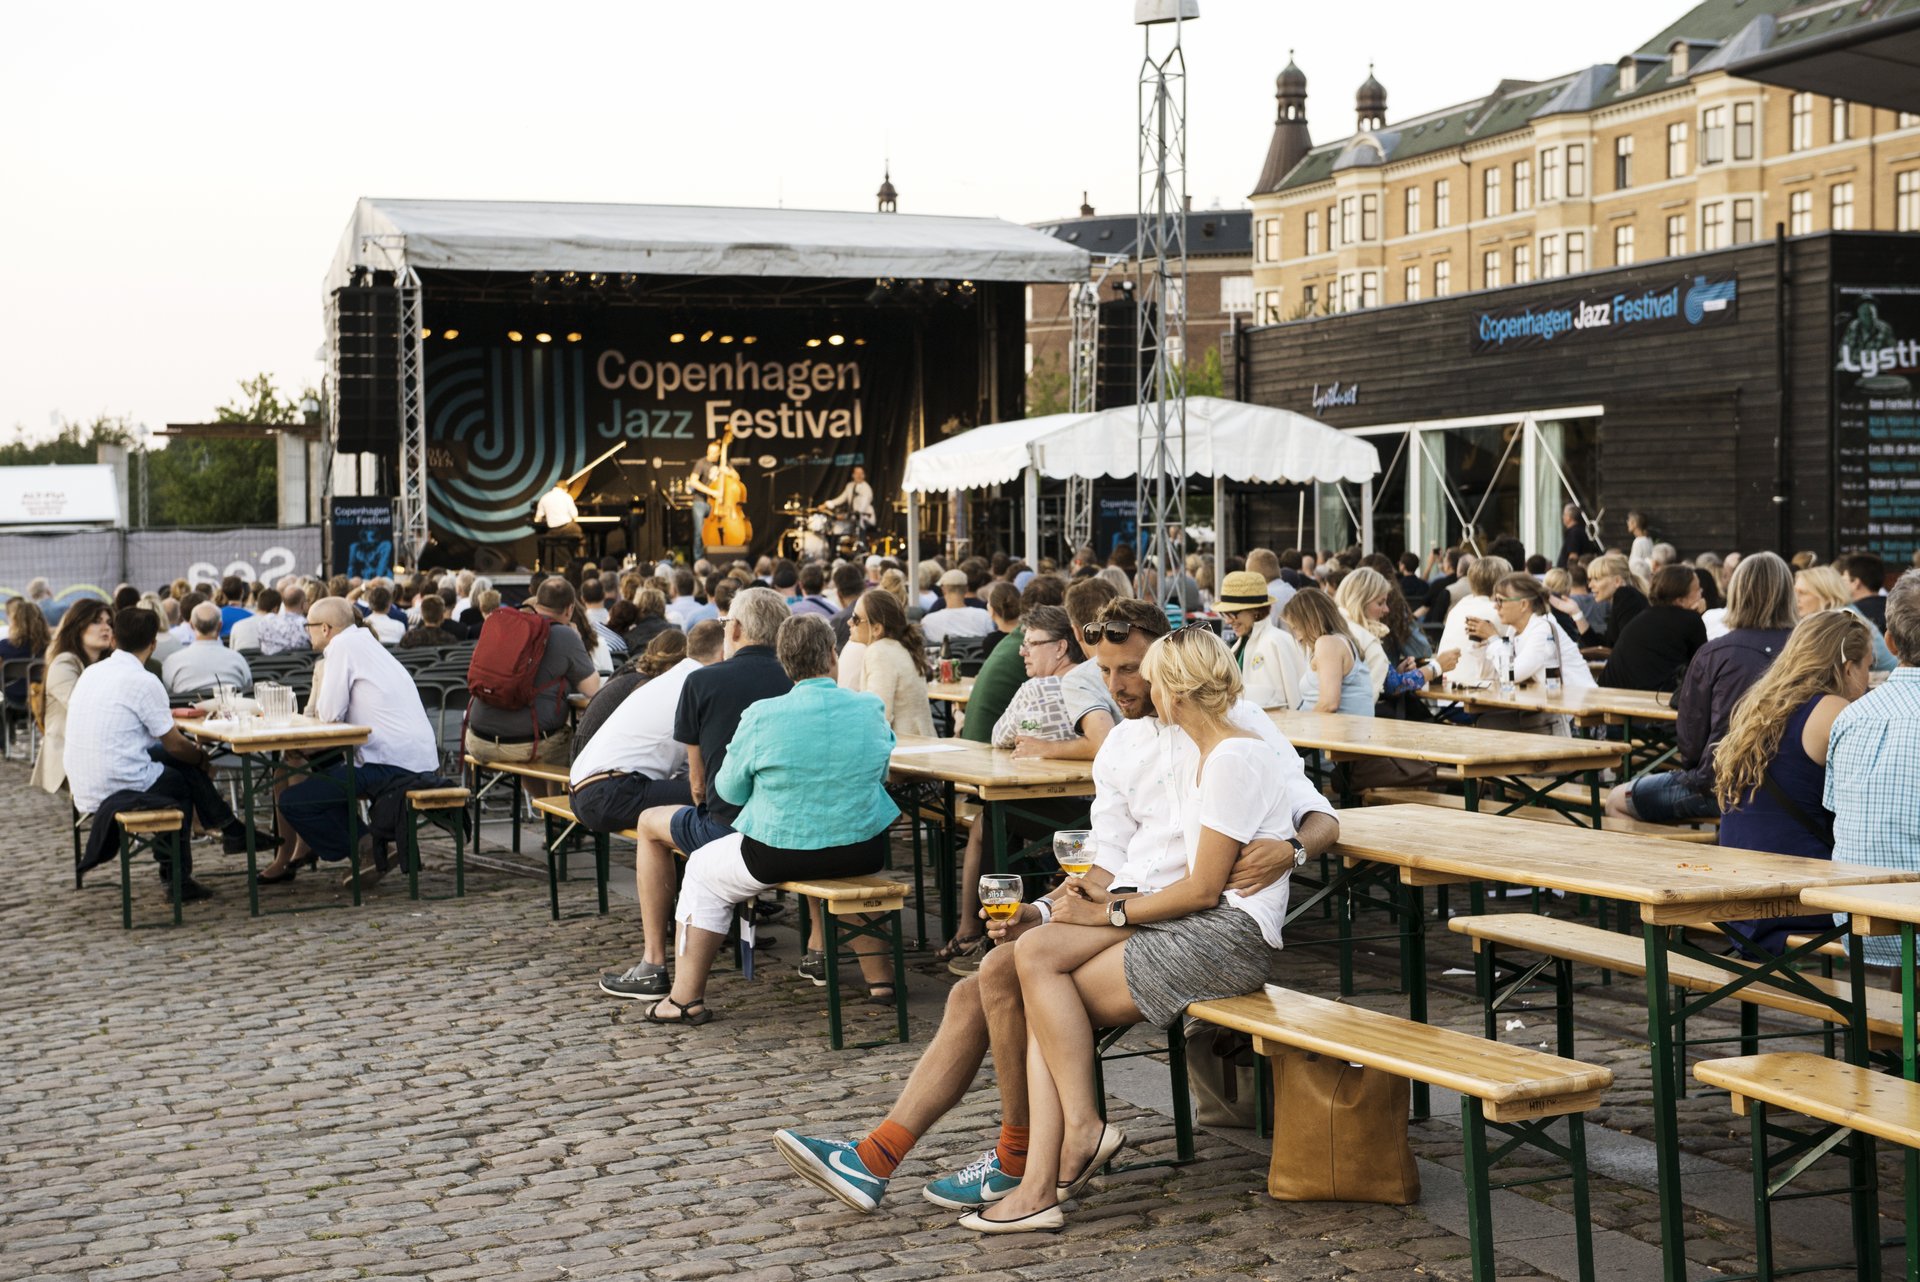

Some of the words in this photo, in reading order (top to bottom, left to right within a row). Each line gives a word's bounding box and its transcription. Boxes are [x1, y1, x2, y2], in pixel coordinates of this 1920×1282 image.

[1479, 309, 1572, 345] Copenhagen
[1574, 300, 1611, 330] Jazz
[1613, 287, 1679, 325] Festival
[597, 349, 861, 400] Copenhagen
[597, 399, 695, 439] Jazz
[705, 399, 863, 439] Festival
[334, 506, 389, 517] Copenhagen
[356, 515, 391, 526] Festival
